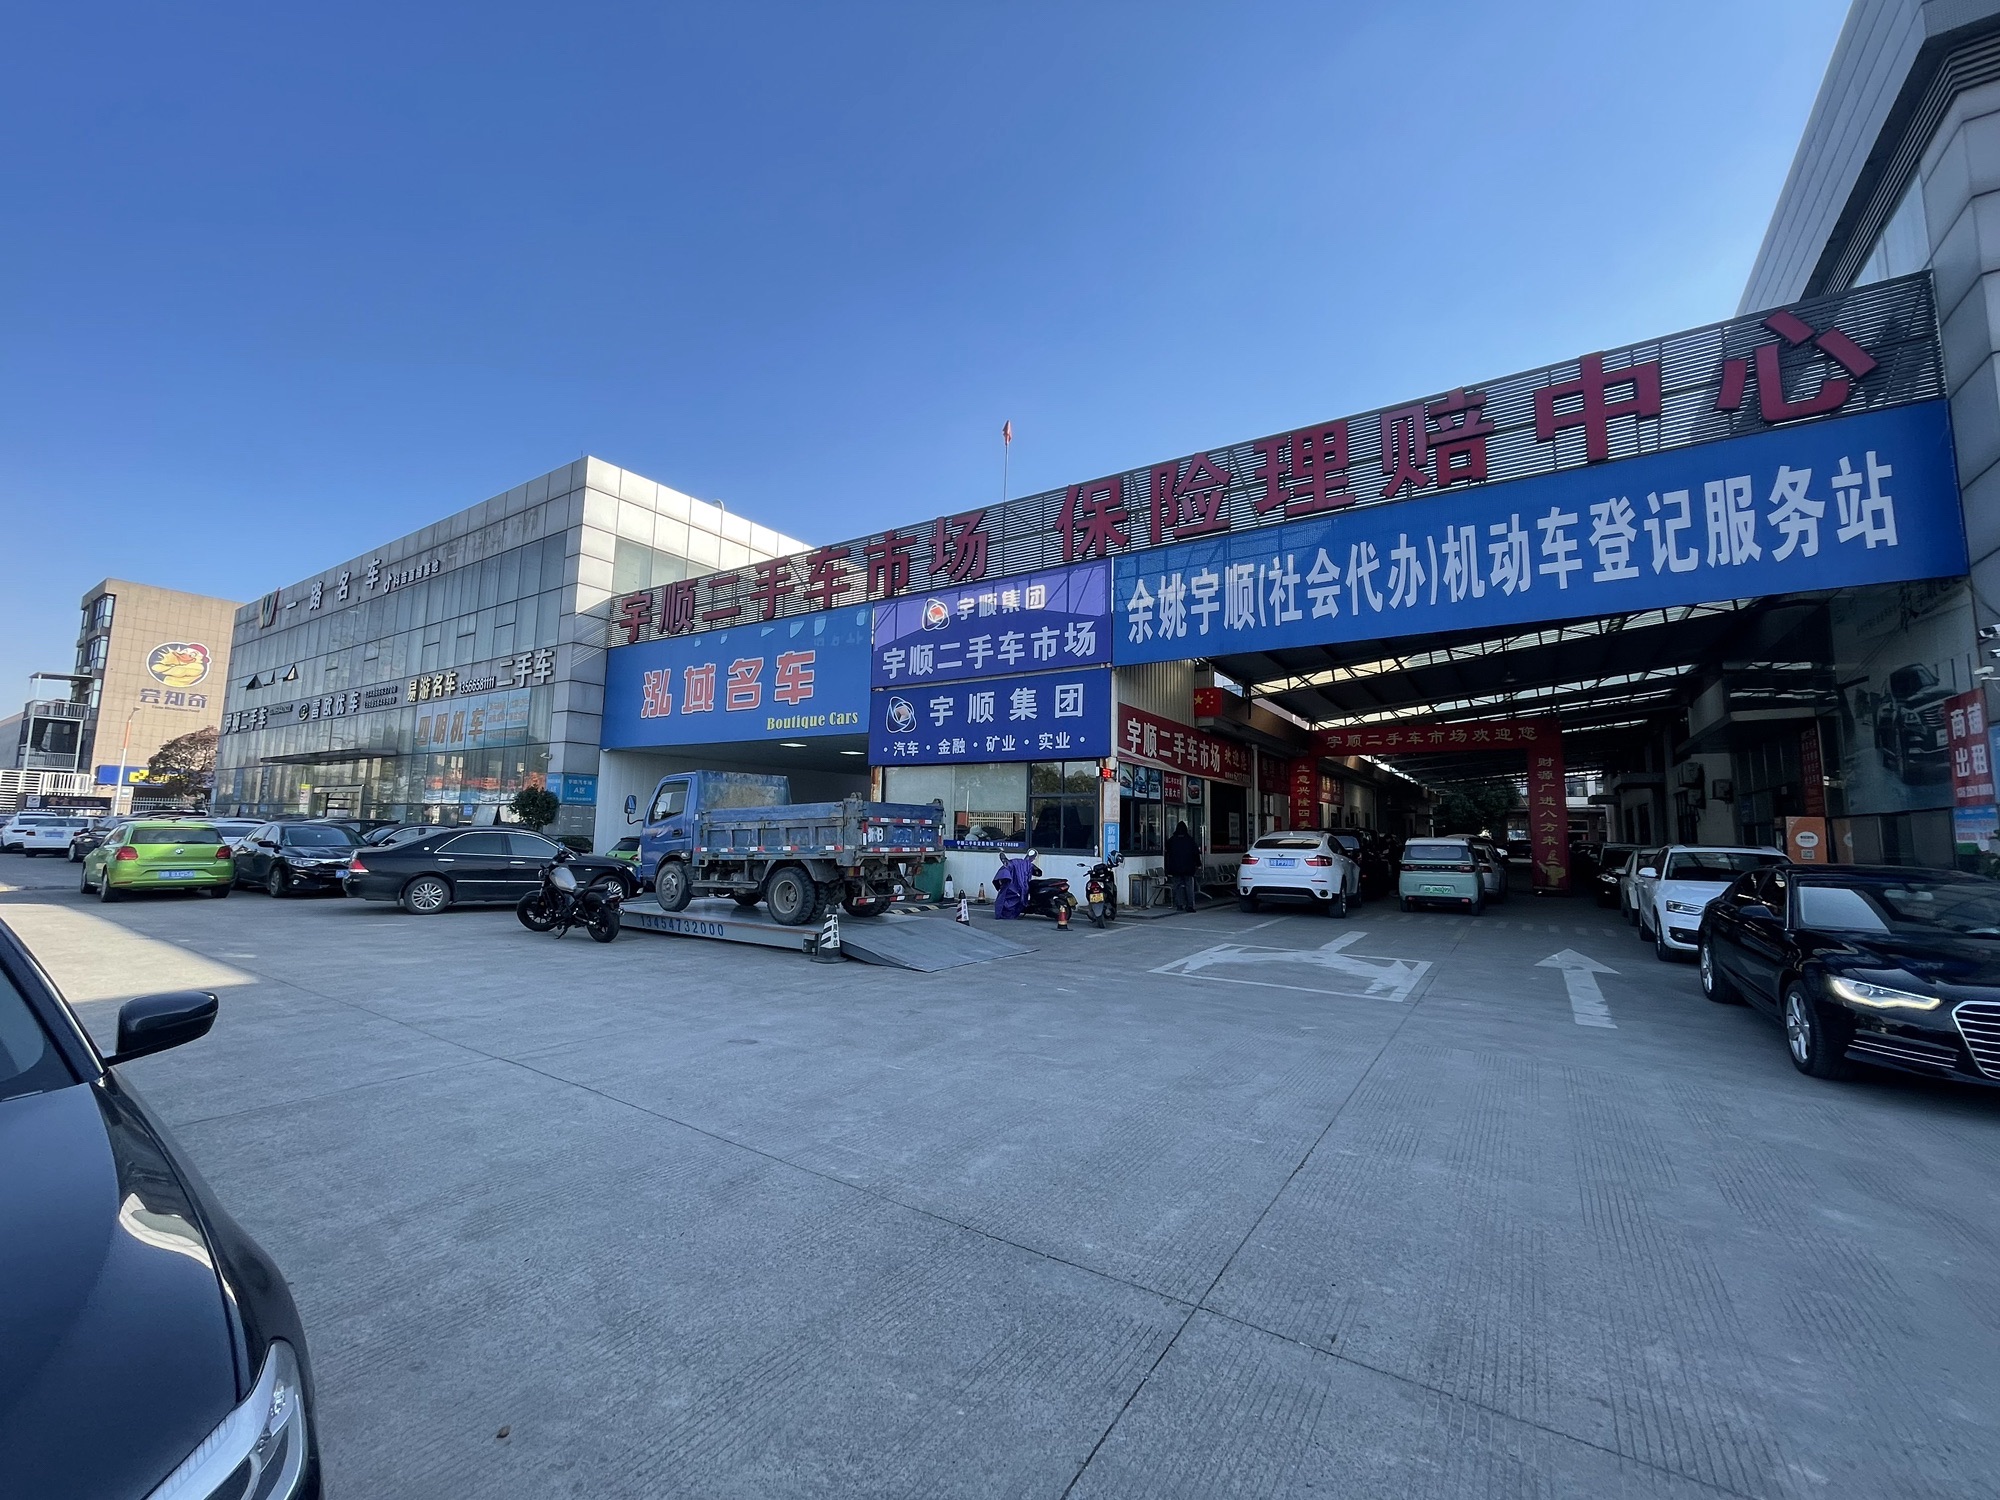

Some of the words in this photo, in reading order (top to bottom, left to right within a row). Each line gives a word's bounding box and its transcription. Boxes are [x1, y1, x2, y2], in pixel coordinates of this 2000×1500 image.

[617, 511, 990, 645] 宇顺二手车市场
[1053, 309, 1880, 563] 保险理赔中心
[956, 584, 1046, 621] 宇顺集团
[497, 648, 554, 688] 二手车
[882, 621, 1097, 681] 宇顺二手车市场
[640, 649, 817, 719] 泓域名车
[766, 713, 826, 731] Boutique
[829, 711, 859, 727] Cars
[929, 684, 1085, 728] 宇顺集团
[1127, 717, 1221, 773] 宇顺二手车市场
[1326, 726, 1538, 749] 宇顺二手车市场欢迎您
[641, 914, 725, 938] 13454732000
